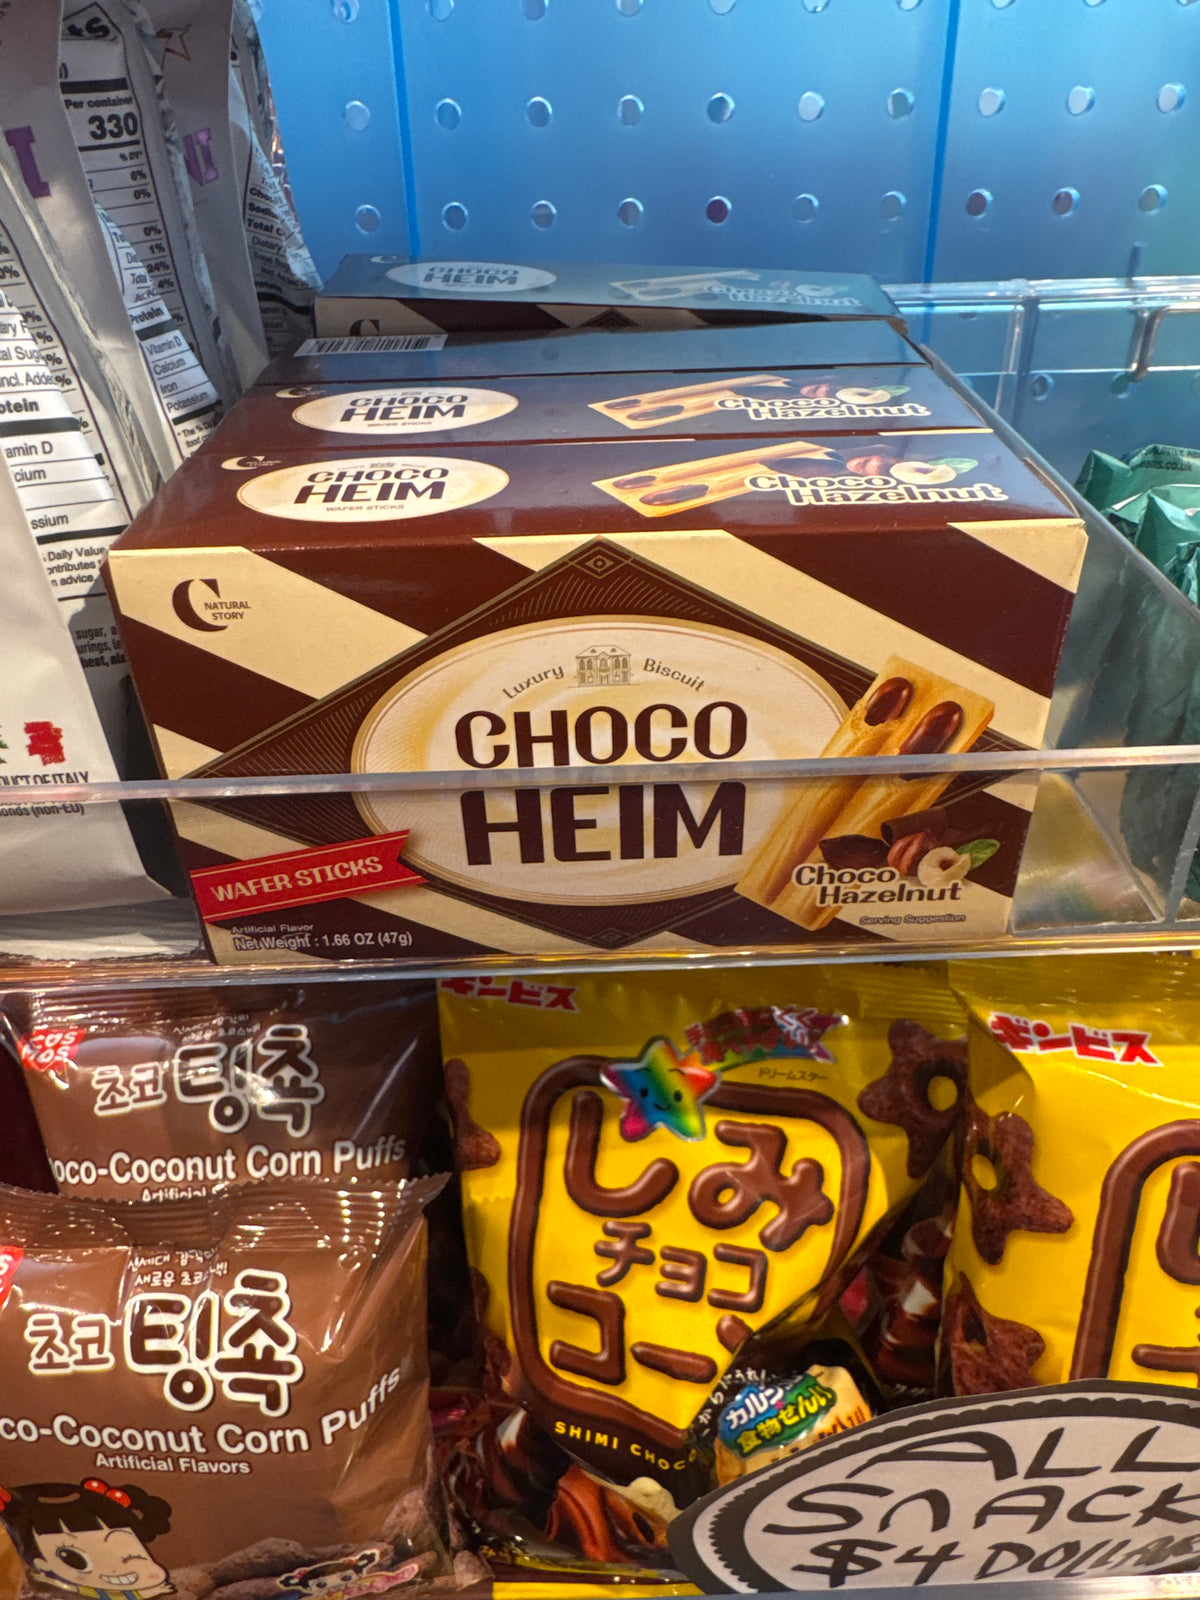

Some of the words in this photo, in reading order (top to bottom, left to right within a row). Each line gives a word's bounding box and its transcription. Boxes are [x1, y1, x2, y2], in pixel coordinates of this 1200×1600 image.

[65, 98, 84, 109] Per
[87, 96, 133, 108] container
[88, 112, 139, 140] 330
[246, 218, 274, 233] Total
[423, 273, 518, 286] HEIM
[146, 339, 173, 357] Vitamin
[173, 335, 182, 347] D
[153, 356, 187, 376] Calcium
[160, 381, 179, 395] Iron
[167, 391, 211, 414] Potassium
[350, 394, 468, 408] CHOCO
[715, 397, 839, 411] Choco
[751, 402, 931, 421] Hazelnut
[340, 403, 467, 423] HEIM
[42, 440, 54, 454] D
[307, 467, 450, 484] CHOCO
[746, 474, 897, 491] Choco
[294, 481, 446, 505] HEIM
[790, 483, 1008, 506] Hazelnut
[48, 550, 73, 564] Daily
[203, 600, 251, 611] NATURAL
[211, 611, 246, 621] STORY
[502, 664, 565, 699] Luxury
[642, 657, 706, 693] Biscuit
[455, 701, 748, 769] CHOCO
[31, 801, 85, 818] (non-EU)
[460, 781, 747, 866] HEIM
[211, 874, 293, 902] WAFER
[294, 856, 384, 887] STICKS
[794, 864, 898, 886] Choco
[818, 881, 963, 906] Hazelnut
[231, 924, 277, 935] Artificial
[280, 922, 314, 933] Flavor
[859, 914, 902, 926] Serving
[903, 913, 966, 924] Suggestion
[234, 936, 261, 952] Net
[261, 933, 311, 951] Weight
[322, 933, 351, 947] 1.66
[353, 932, 375, 945] OZ
[377, 930, 413, 948] (47g)
[988, 1011, 1165, 1067] ギンビス
[759, 1066, 830, 1082] ドリームスター
[92, 1064, 168, 1117] 초코
[246, 1144, 322, 1179] Corn
[333, 1134, 406, 1174] Puffs
[564, 1089, 835, 1253] しみ
[594, 1220, 769, 1313] チョコ
[25, 1312, 115, 1376] 초코
[216, 1422, 310, 1456] Corn
[320, 1365, 402, 1447] Puffs
[554, 1420, 619, 1450] SHIMI
[95, 1451, 175, 1473] Artificial
[178, 1457, 251, 1475] Flavors
[845, 1425, 1200, 1481] ALL
[791, 1537, 965, 1589] $4
